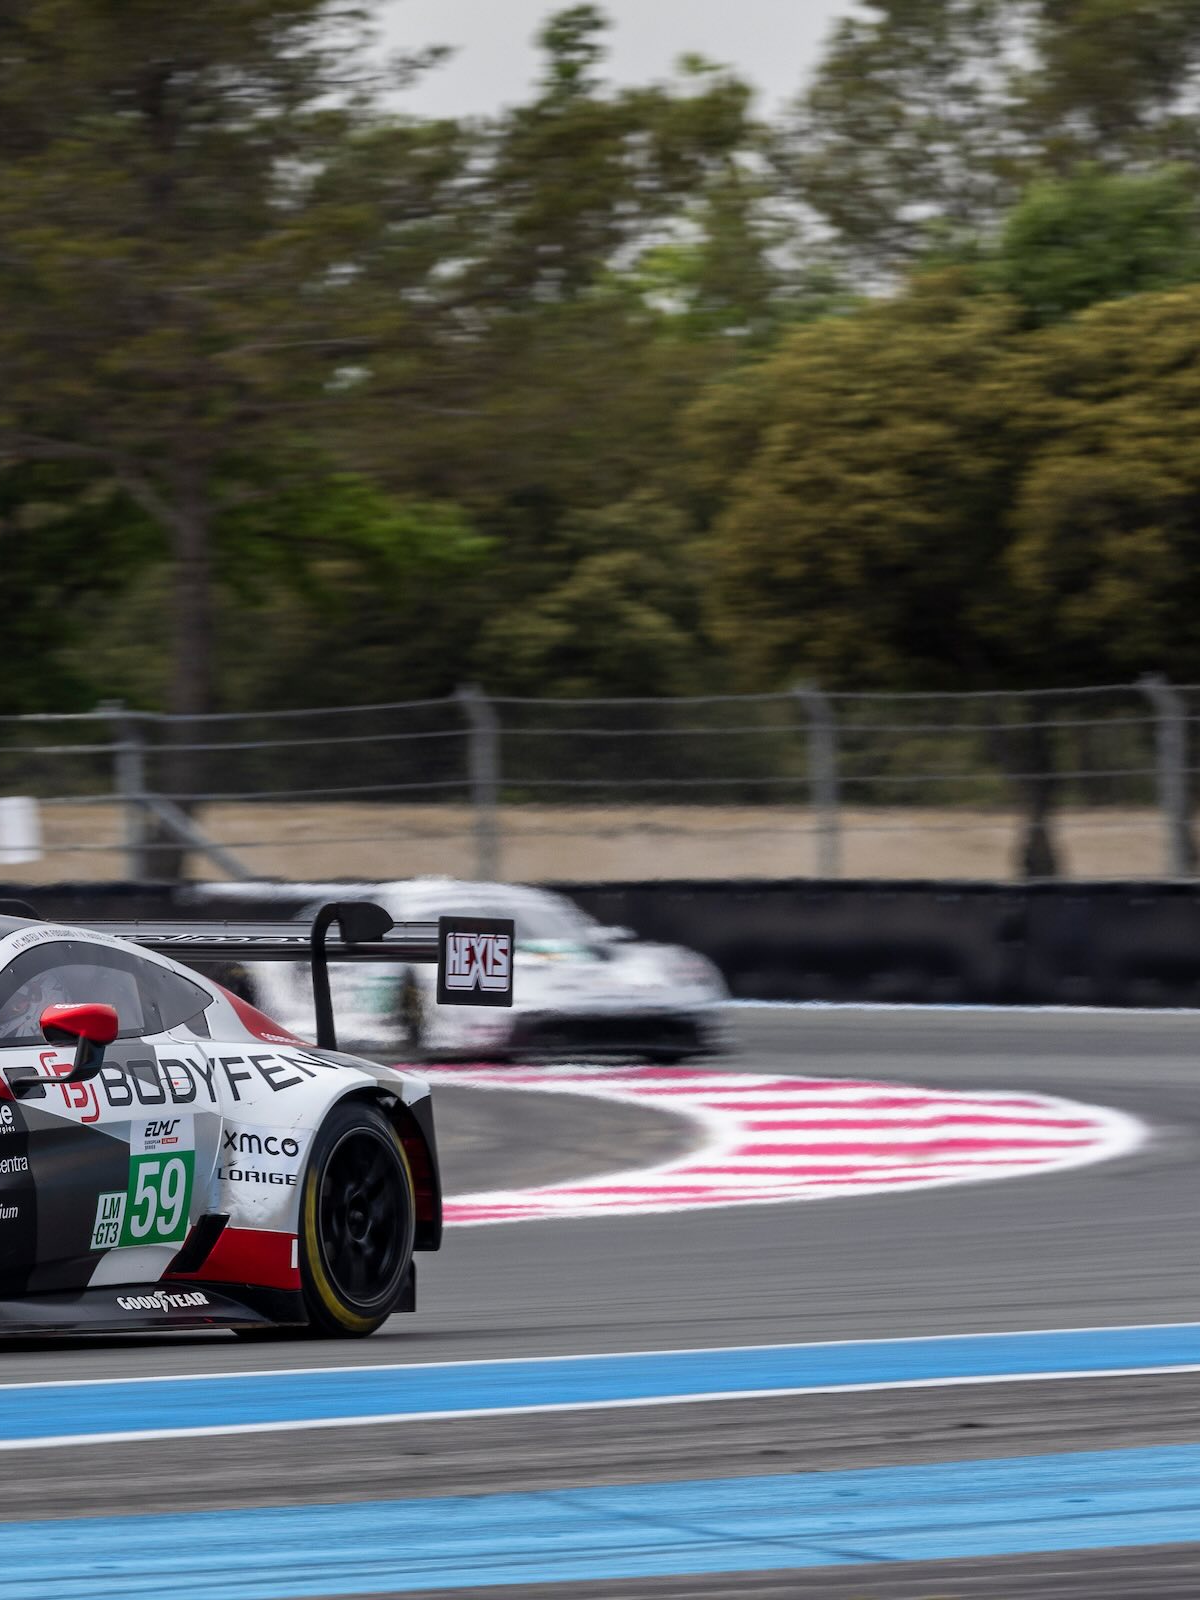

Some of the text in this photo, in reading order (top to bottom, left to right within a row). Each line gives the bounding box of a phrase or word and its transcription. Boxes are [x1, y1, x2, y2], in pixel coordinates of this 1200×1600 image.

[446, 932, 510, 992] HEXIS
[223, 1129, 299, 1157] xmco
[101, 1196, 122, 1220] LM
[130, 1157, 186, 1238] 59
[95, 1222, 119, 1245] GT3
[116, 1290, 210, 1313] GOODYEAR
